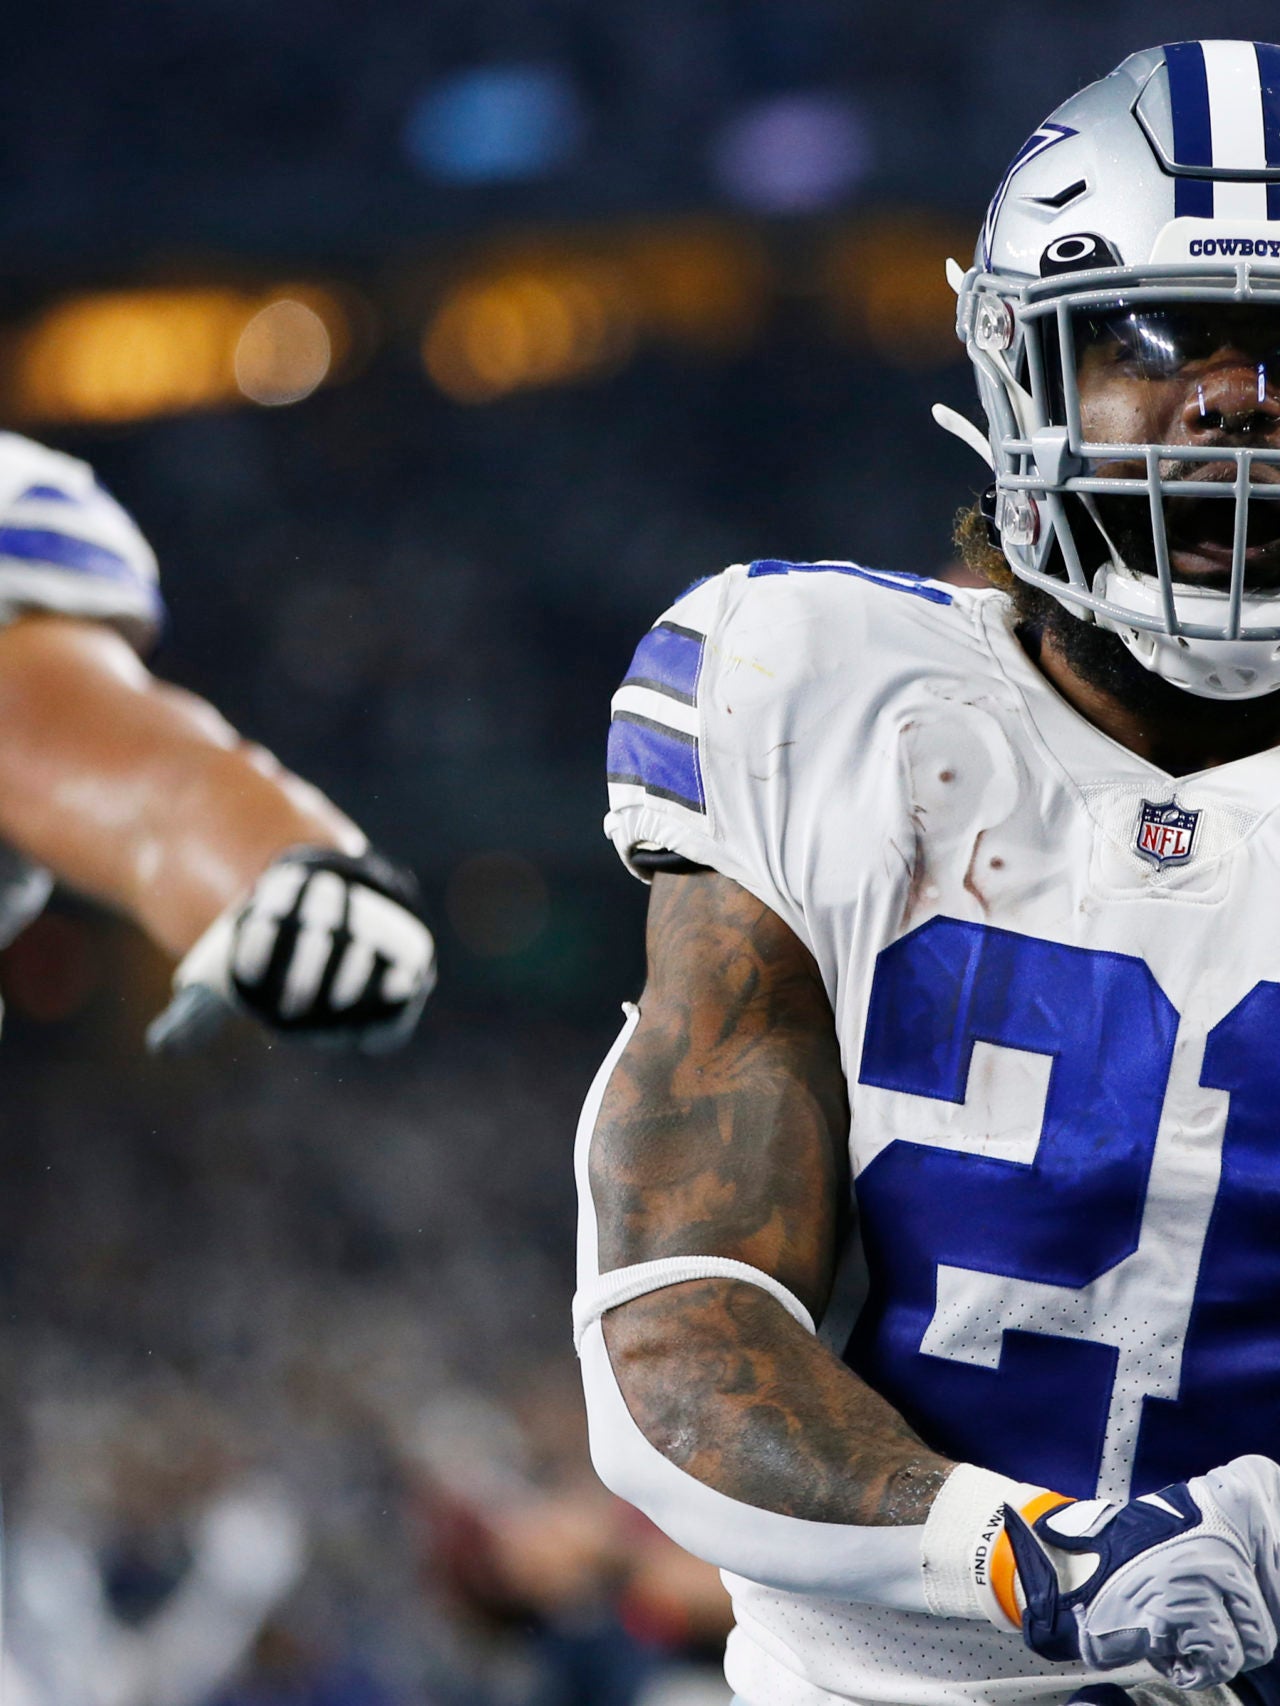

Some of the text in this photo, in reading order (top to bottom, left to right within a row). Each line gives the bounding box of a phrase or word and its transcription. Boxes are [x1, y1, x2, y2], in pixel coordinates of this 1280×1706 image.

[1141, 824, 1186, 857] NFL
[981, 1531, 995, 1543] A
[975, 1545, 988, 1586] FIND
